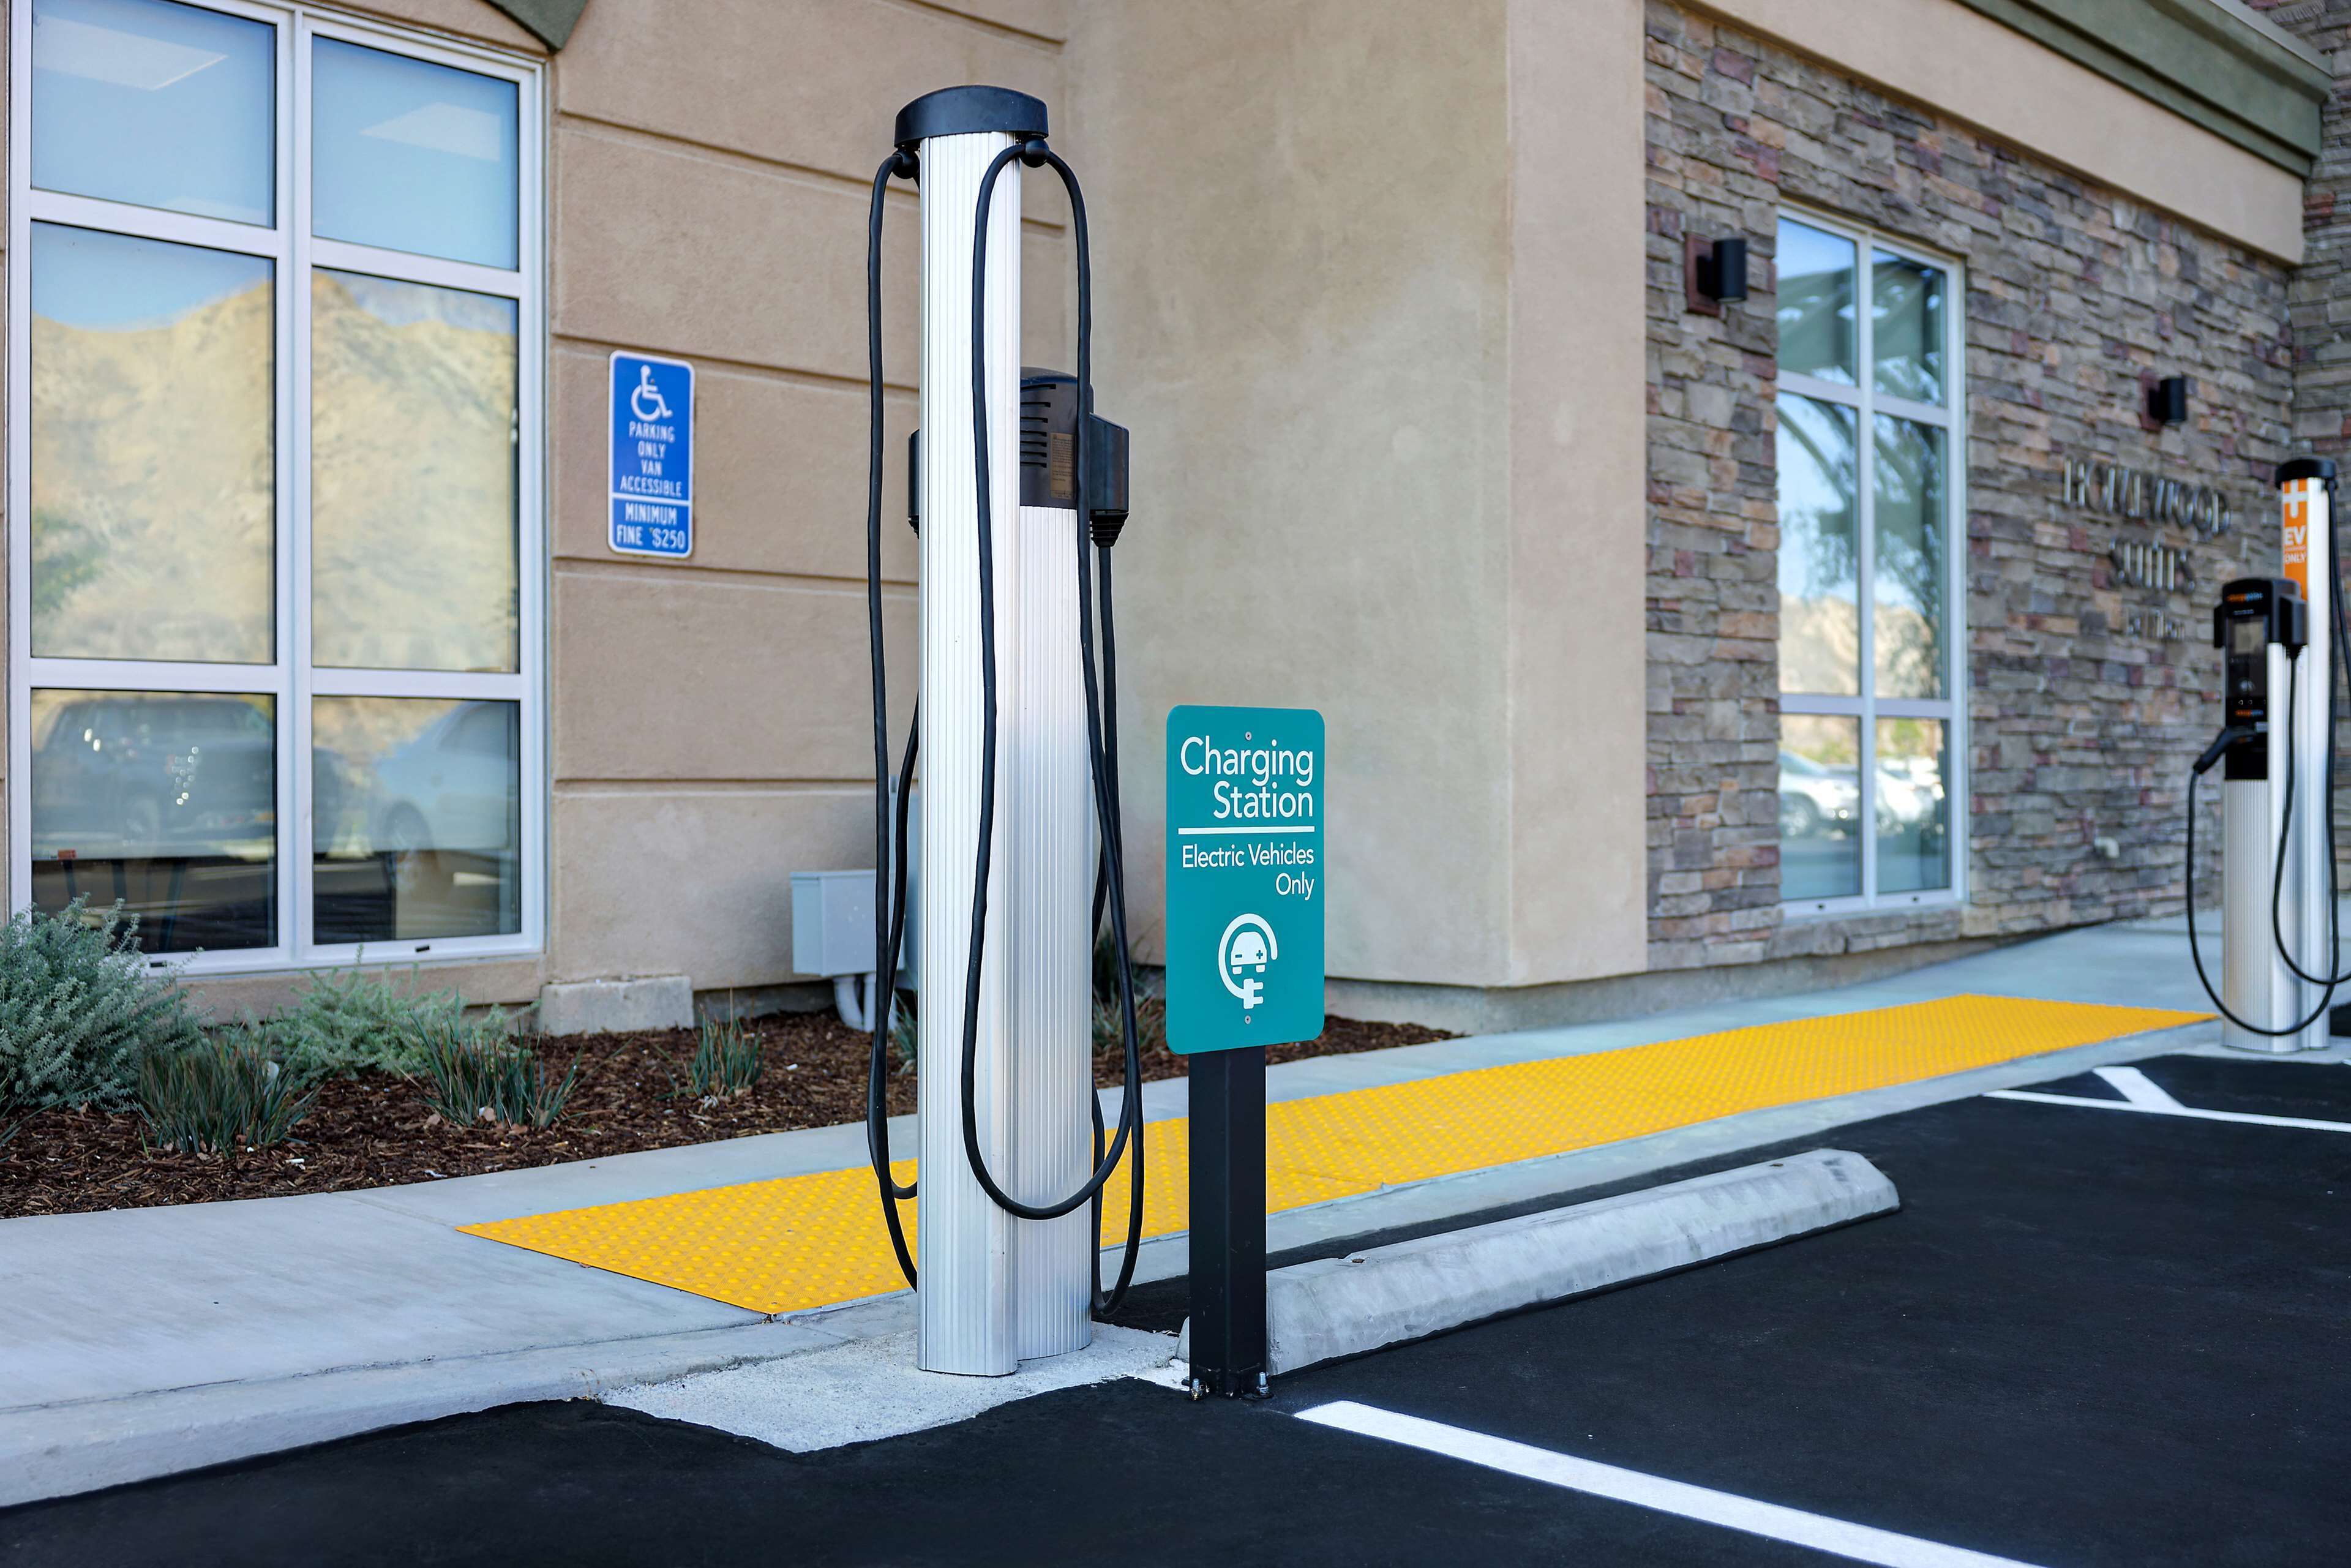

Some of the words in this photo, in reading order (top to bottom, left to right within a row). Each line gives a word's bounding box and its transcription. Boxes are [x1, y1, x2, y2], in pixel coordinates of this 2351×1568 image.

[629, 421, 675, 443] PARKING
[637, 440, 666, 459] ONLY
[641, 460, 662, 476] VAN
[620, 475, 681, 497] ACCESSIBLE
[625, 502, 677, 525] MINIMUM
[617, 524, 642, 546] FINE
[652, 528, 685, 549] $250
[2284, 526, 2306, 545] EV
[2284, 552, 2307, 565] ONLY
[1180, 735, 1313, 787] Charging
[1213, 781, 1313, 819] Station
[1182, 844, 1245, 868] Electric
[1248, 841, 1314, 866] Vehicles
[1275, 871, 1314, 901] Only
